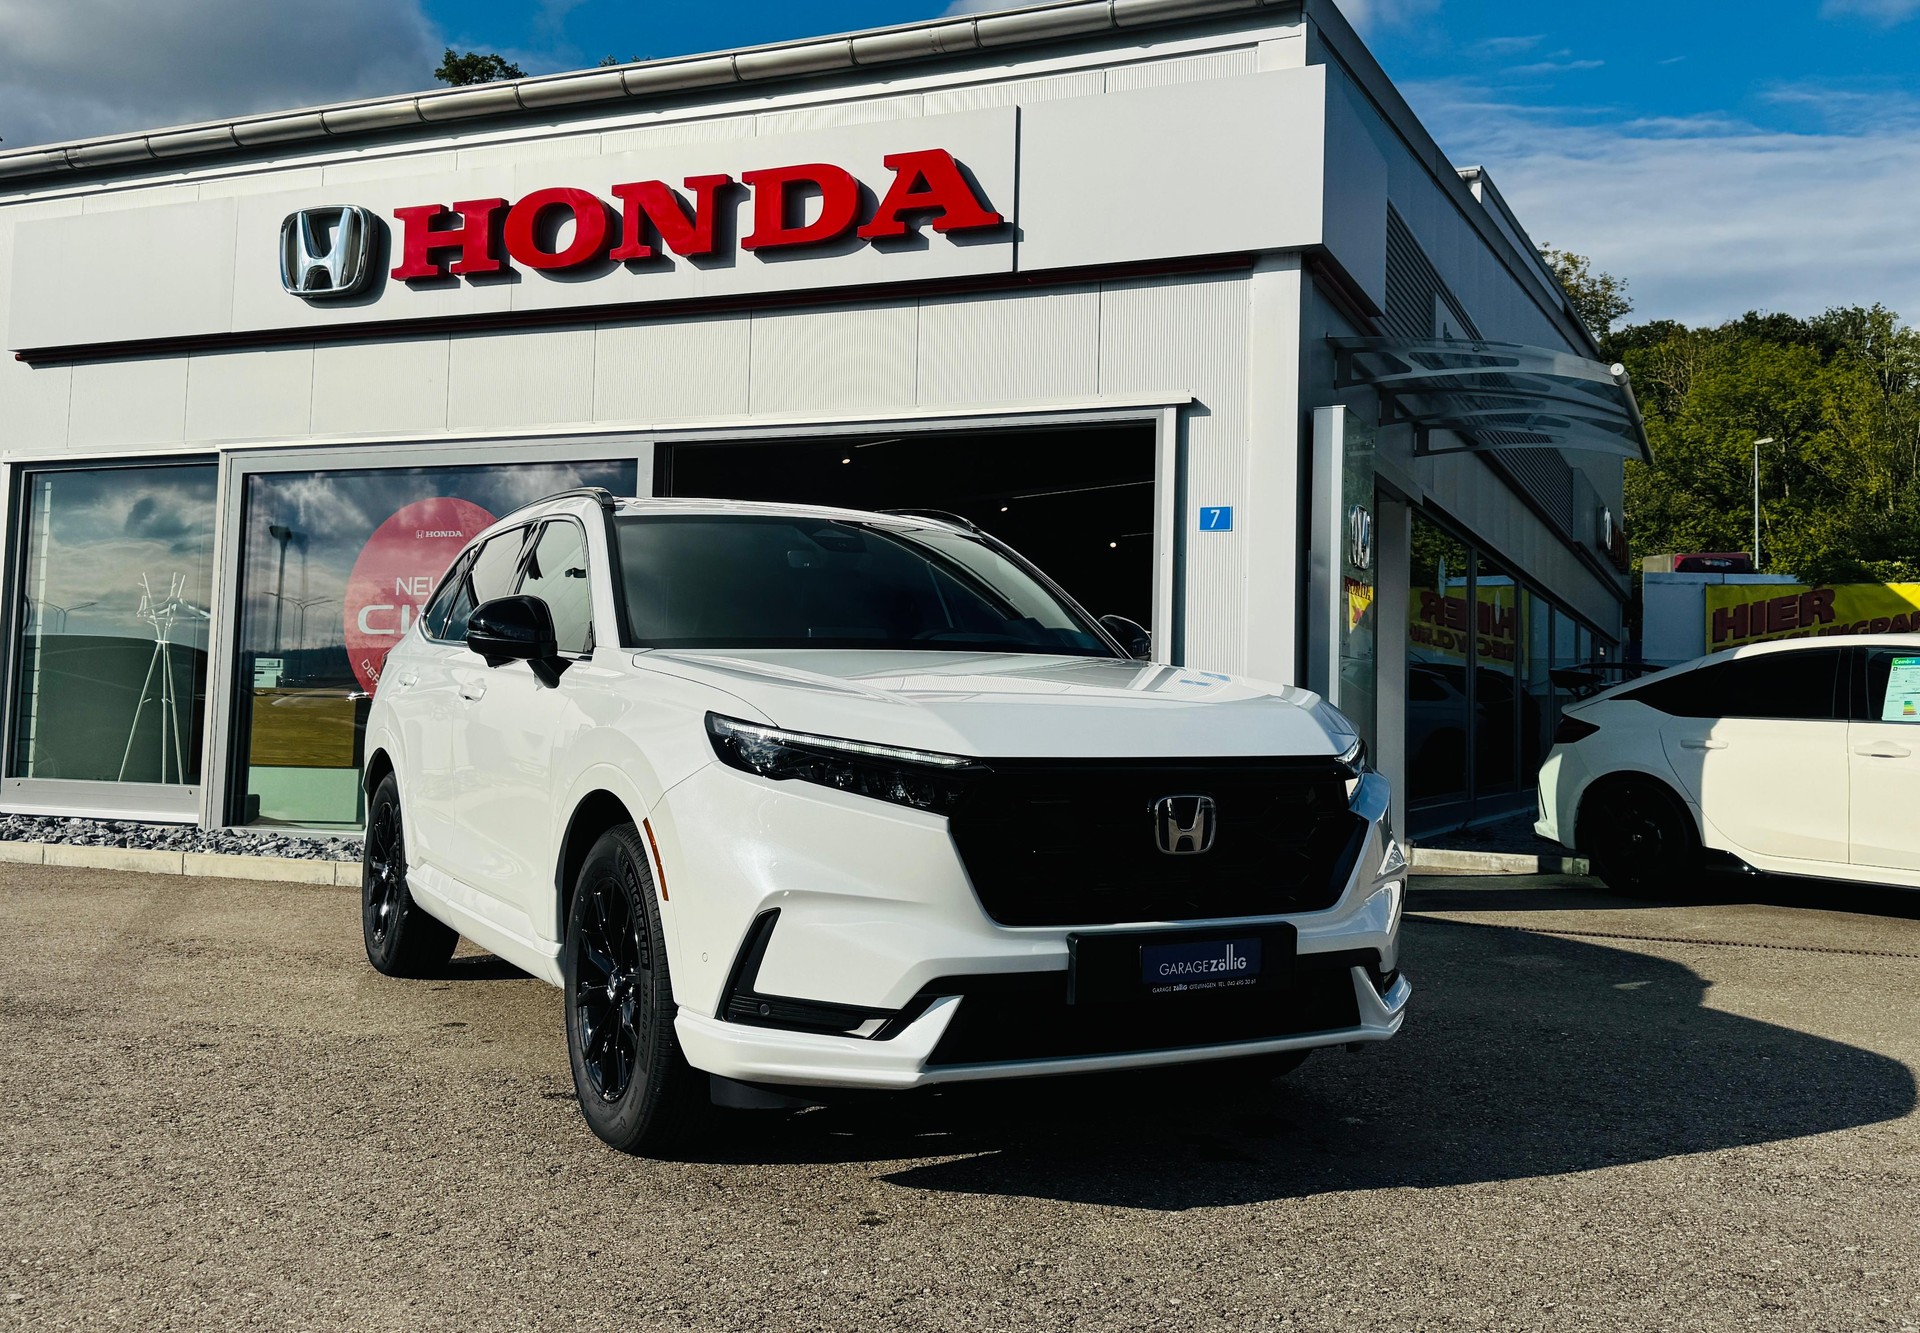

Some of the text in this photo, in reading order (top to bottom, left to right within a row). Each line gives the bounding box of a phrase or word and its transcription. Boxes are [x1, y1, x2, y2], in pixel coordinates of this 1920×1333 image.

[391, 148, 1005, 281] HONDA
[425, 530, 463, 538] HONDA
[1210, 509, 1220, 528] 7
[1713, 588, 1836, 643] HIER
[626, 872, 648, 965] MICHELIN
